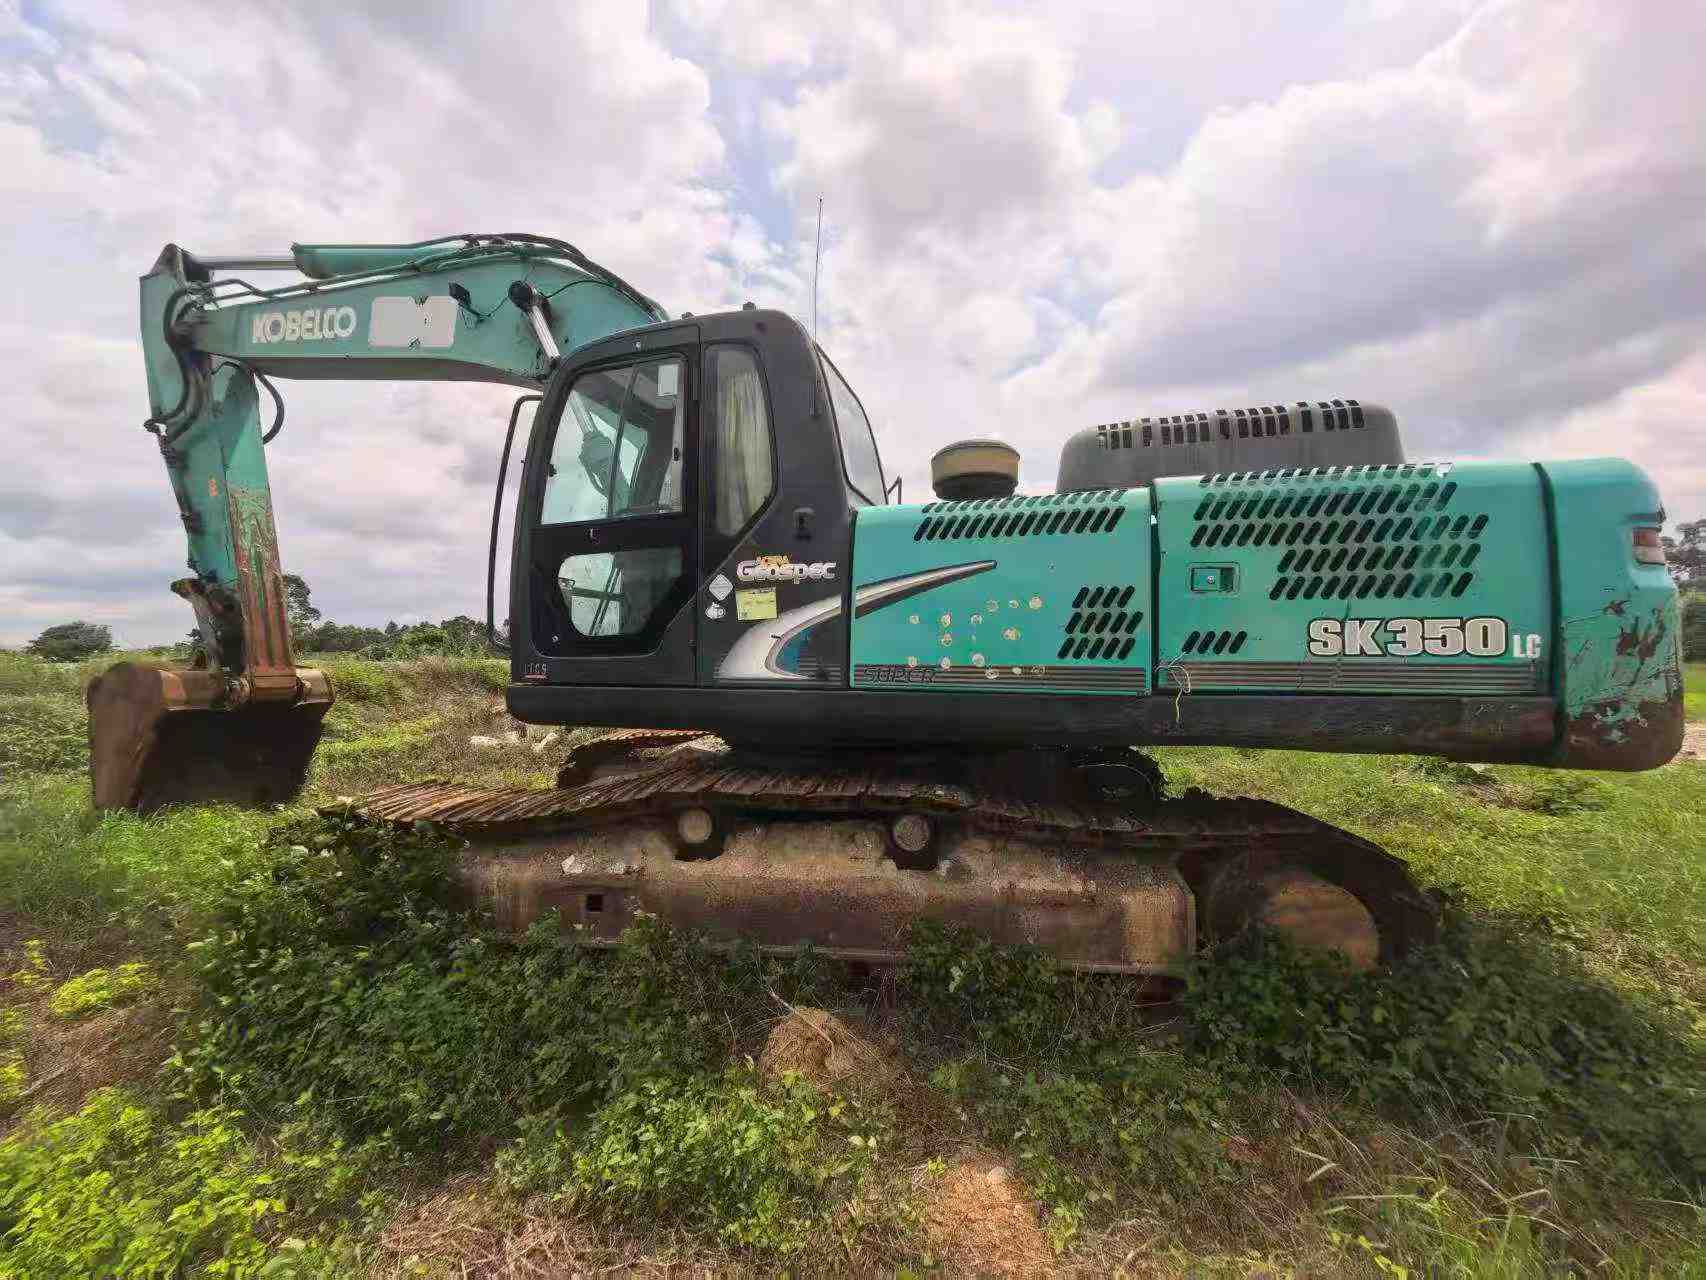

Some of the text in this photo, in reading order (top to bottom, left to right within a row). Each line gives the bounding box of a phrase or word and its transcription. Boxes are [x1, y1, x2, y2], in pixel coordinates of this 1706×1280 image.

[252, 306, 357, 343] KOBELCO
[1308, 616, 1543, 658] SK350 LC
